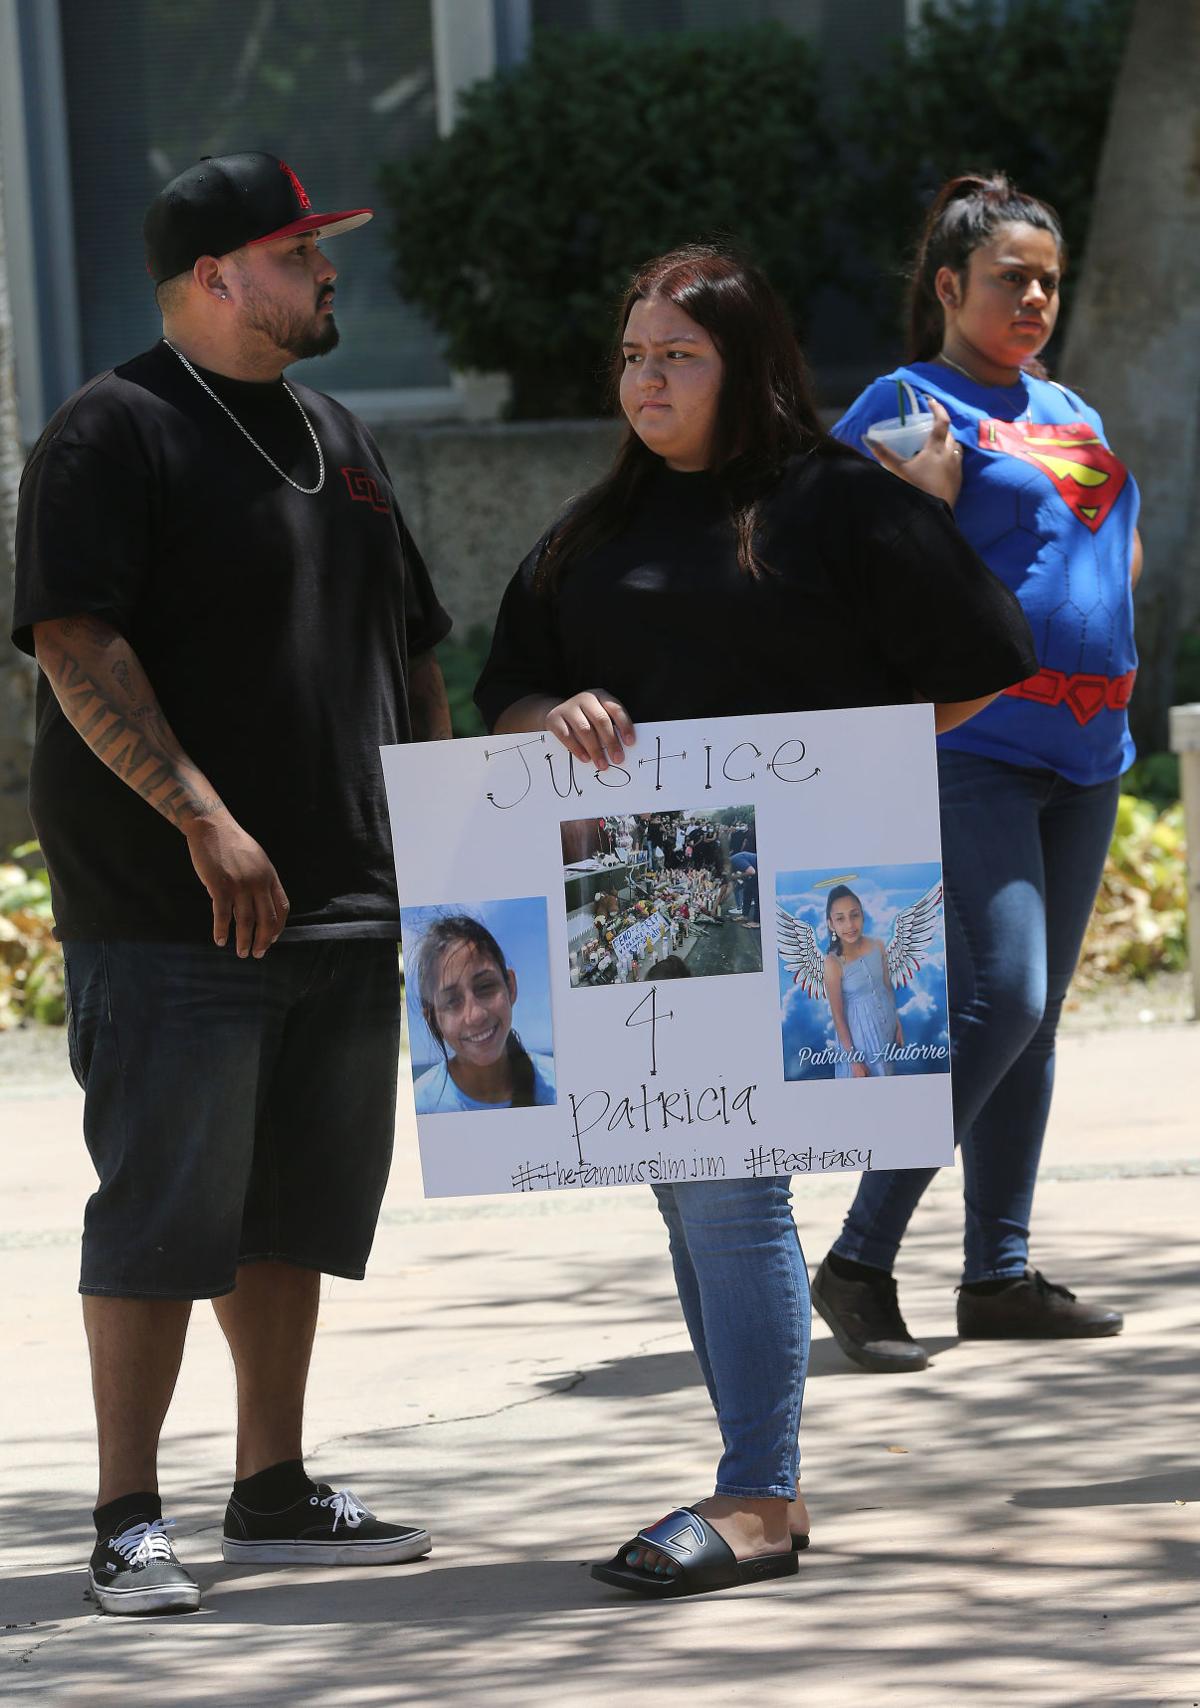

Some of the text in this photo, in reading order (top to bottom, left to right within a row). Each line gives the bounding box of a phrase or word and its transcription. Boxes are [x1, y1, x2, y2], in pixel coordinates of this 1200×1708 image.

[625, 985, 674, 1076] 4
[799, 1042, 949, 1067] Patricia Alatorre
